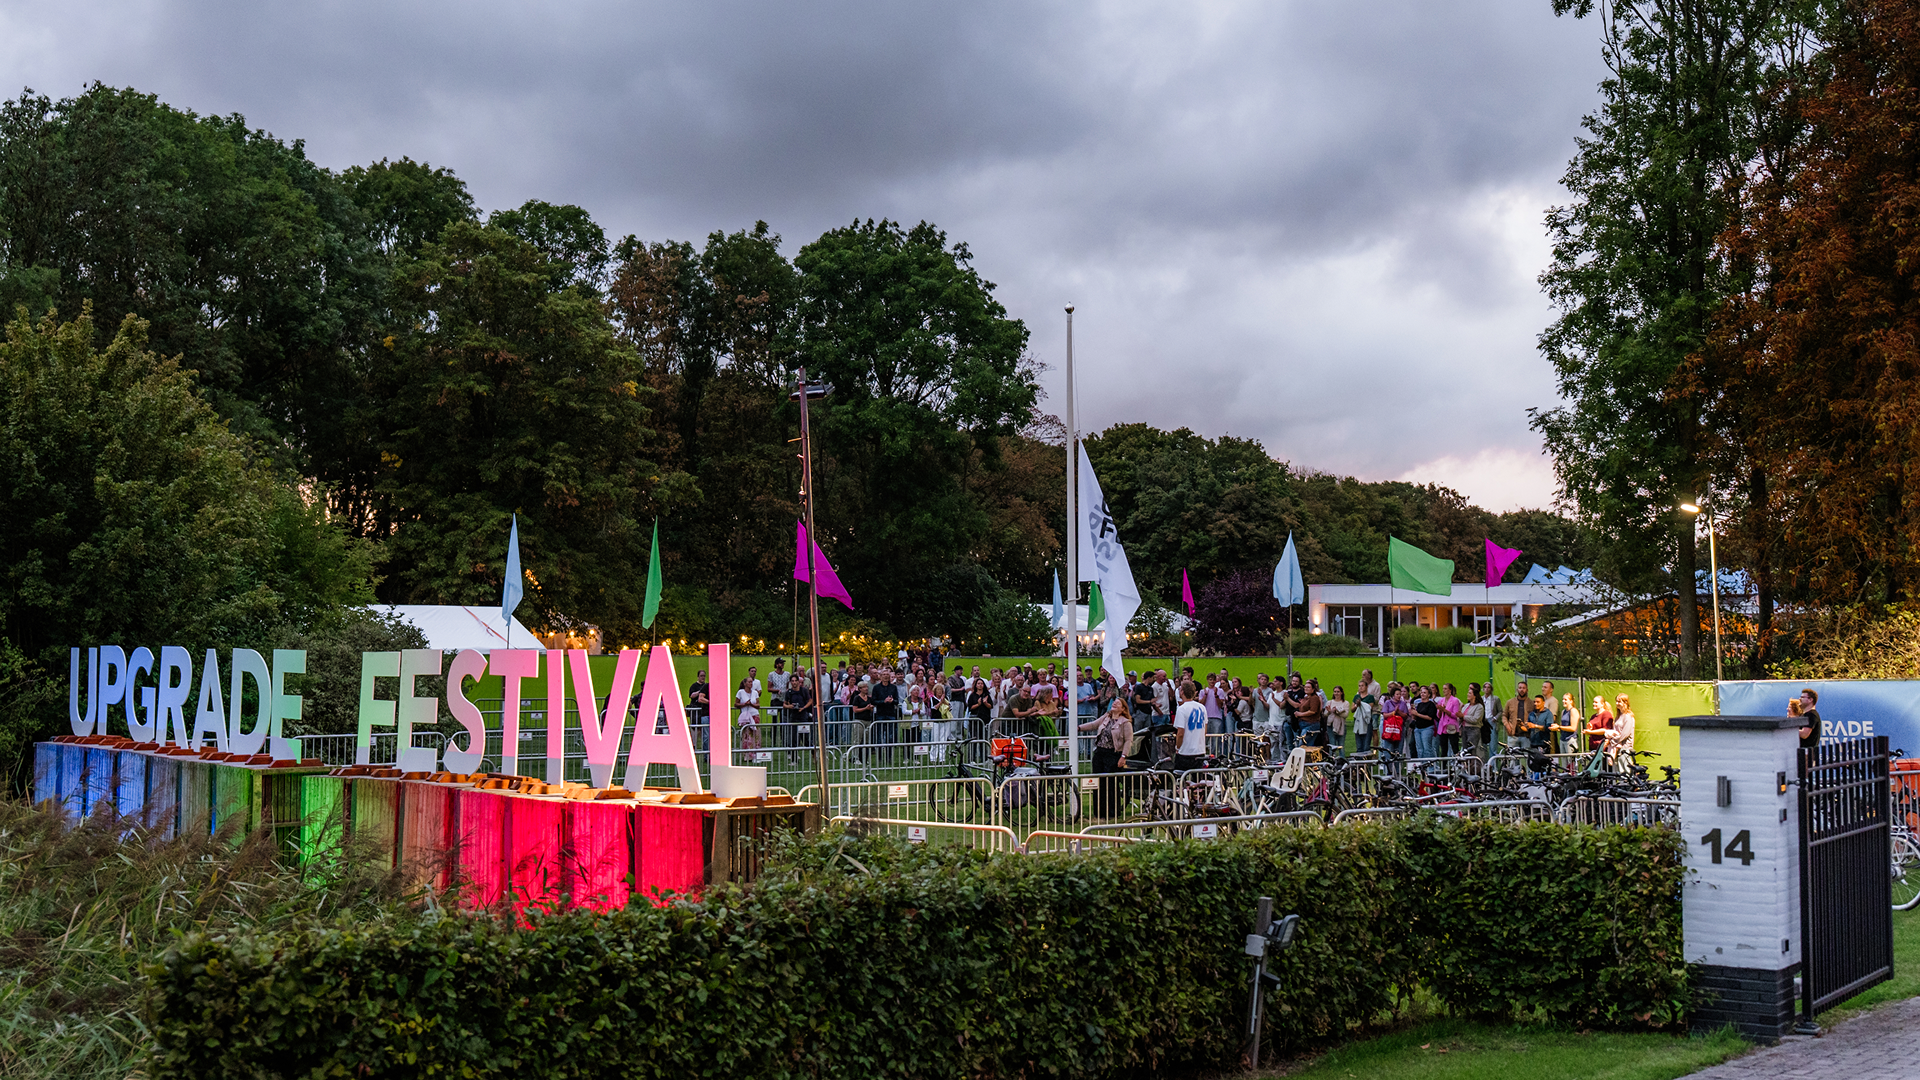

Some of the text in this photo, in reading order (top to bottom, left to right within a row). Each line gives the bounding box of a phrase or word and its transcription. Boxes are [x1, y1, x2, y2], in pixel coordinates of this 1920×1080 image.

[70, 643, 767, 801] UPGRADE FESTIVAL
[1701, 828, 1755, 866] 14
